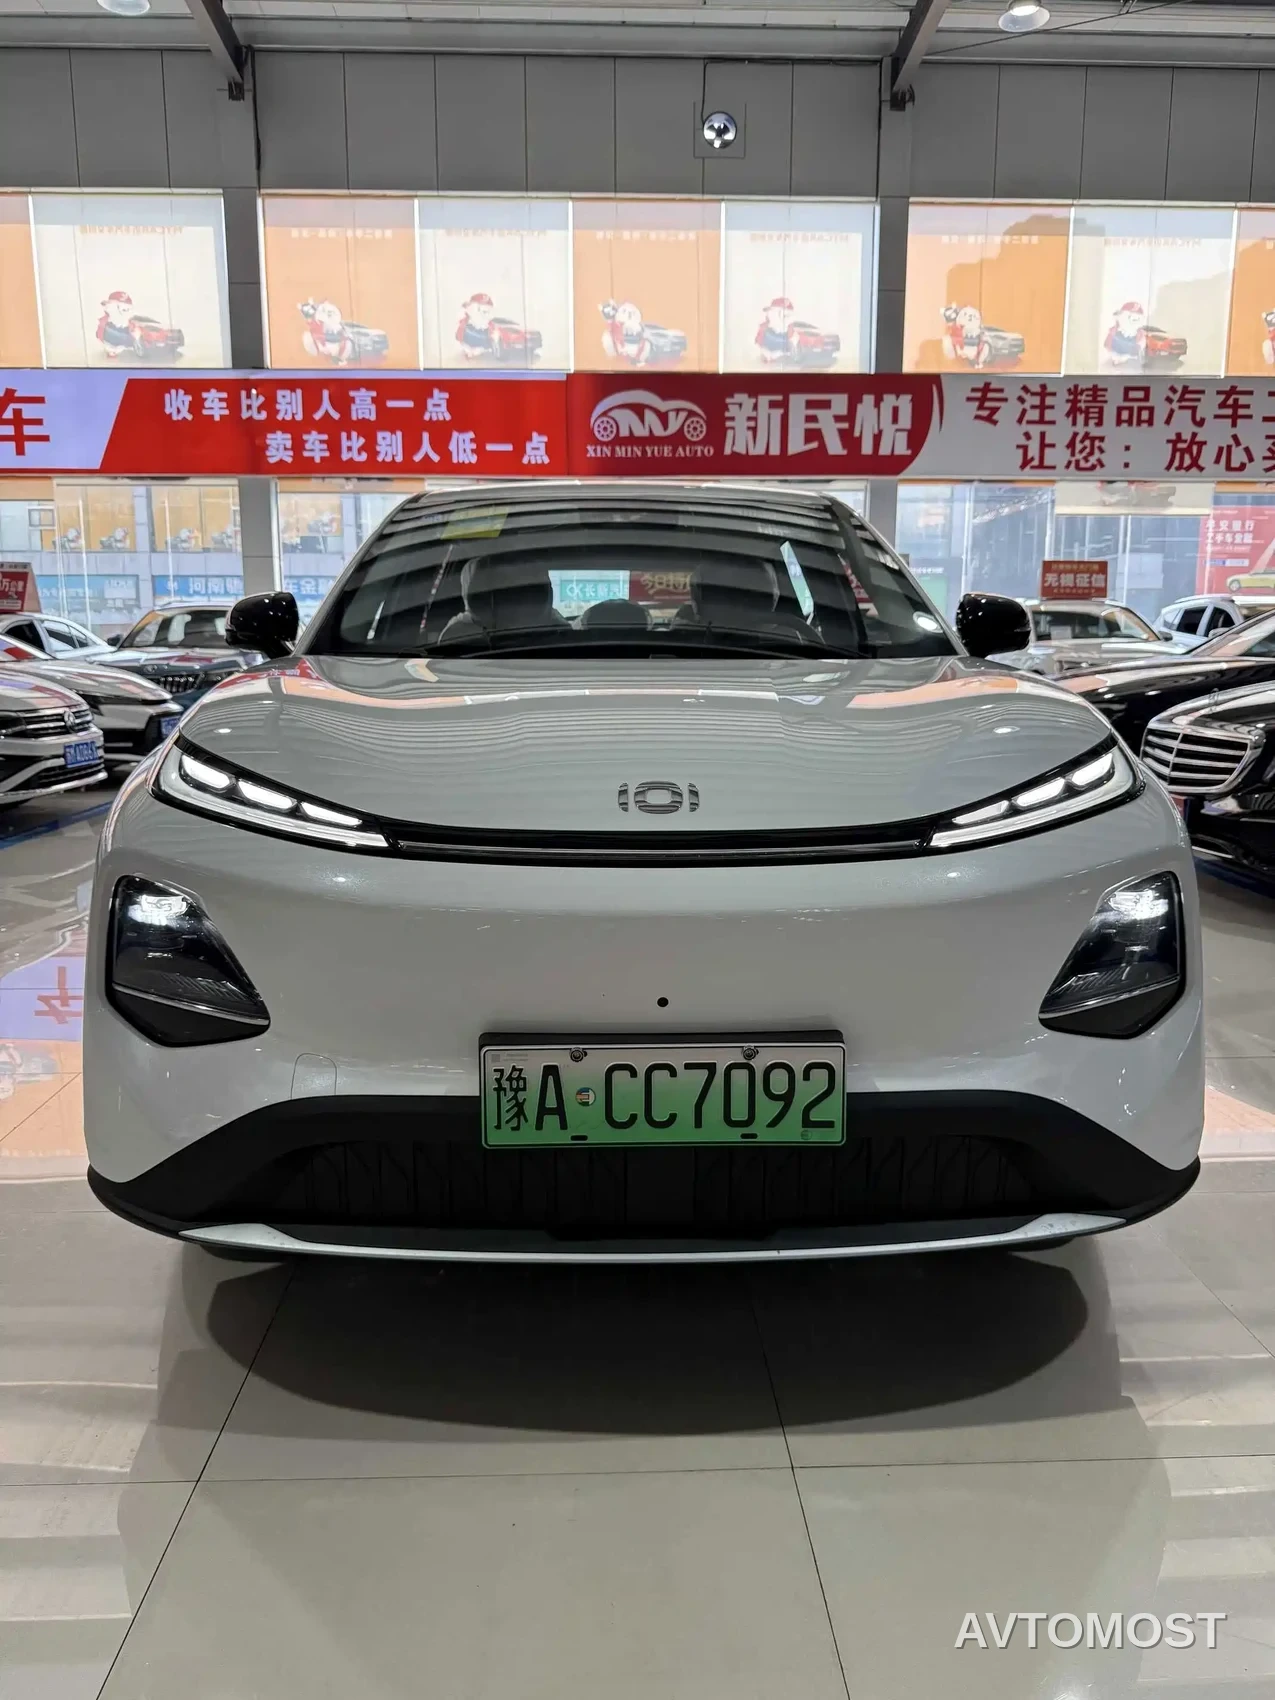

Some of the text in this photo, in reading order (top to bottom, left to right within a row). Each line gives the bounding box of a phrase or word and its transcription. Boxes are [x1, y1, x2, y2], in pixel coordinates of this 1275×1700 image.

[164, 388, 451, 421] 收车比别人高一点
[723, 393, 913, 456] 新民悦
[265, 430, 550, 464] 卖车比别人低一点
[586, 444, 714, 457] XIN MIN YUE AUTO
[493, 1060, 836, 1132] 豫A CC7092
